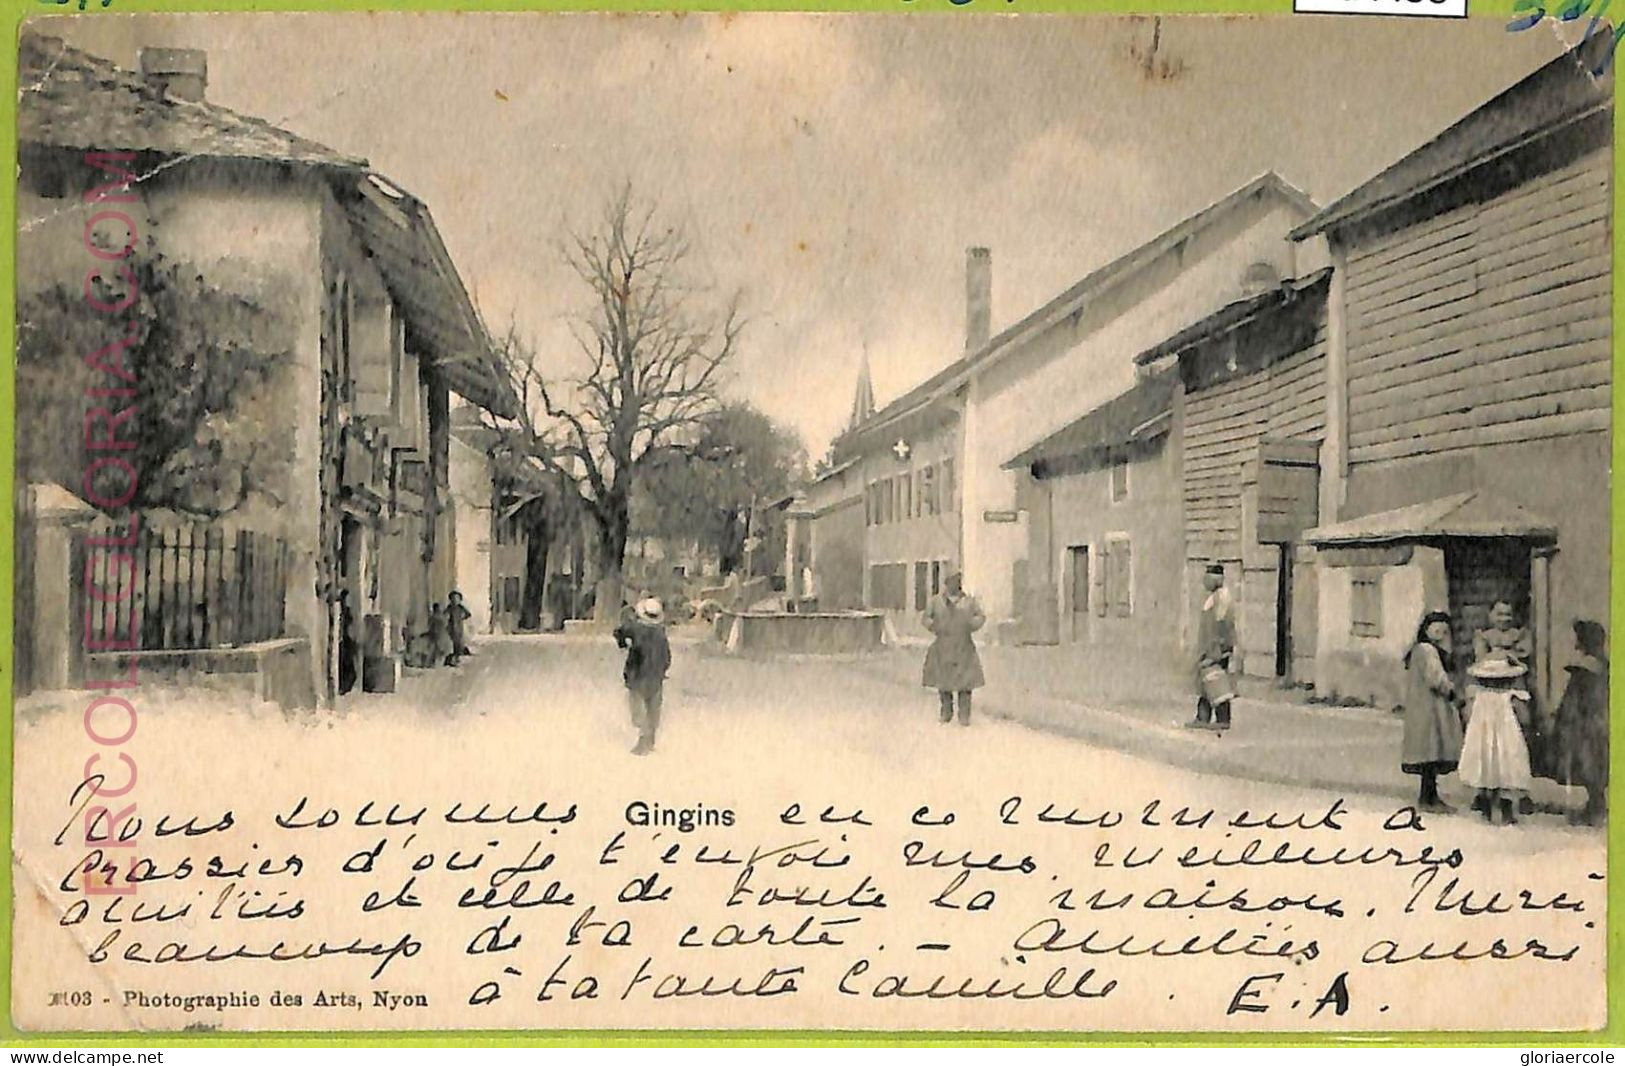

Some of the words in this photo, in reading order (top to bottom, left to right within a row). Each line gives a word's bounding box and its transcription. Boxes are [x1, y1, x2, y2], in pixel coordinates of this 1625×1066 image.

[54, 774, 235, 846] Nous
[275, 797, 578, 828] sommes
[625, 801, 736, 832] Gingins
[780, 803, 872, 826] en
[911, 805, 955, 826] ce
[903, 840, 1037, 874] mes
[362, 876, 422, 912] et
[617, 872, 673, 902] de
[726, 865, 888, 907] toute
[930, 869, 996, 911] la
[88, 928, 422, 980] beaucoup
[466, 915, 522, 955] de
[566, 905, 633, 946] ta
[1361, 921, 1595, 964] aussi
[537, 954, 599, 1002] ta
[123, 990, 261, 1013] Photographie
[270, 990, 303, 1008] des
[312, 990, 363, 1011] Arts,
[372, 990, 429, 1012] Nyon
